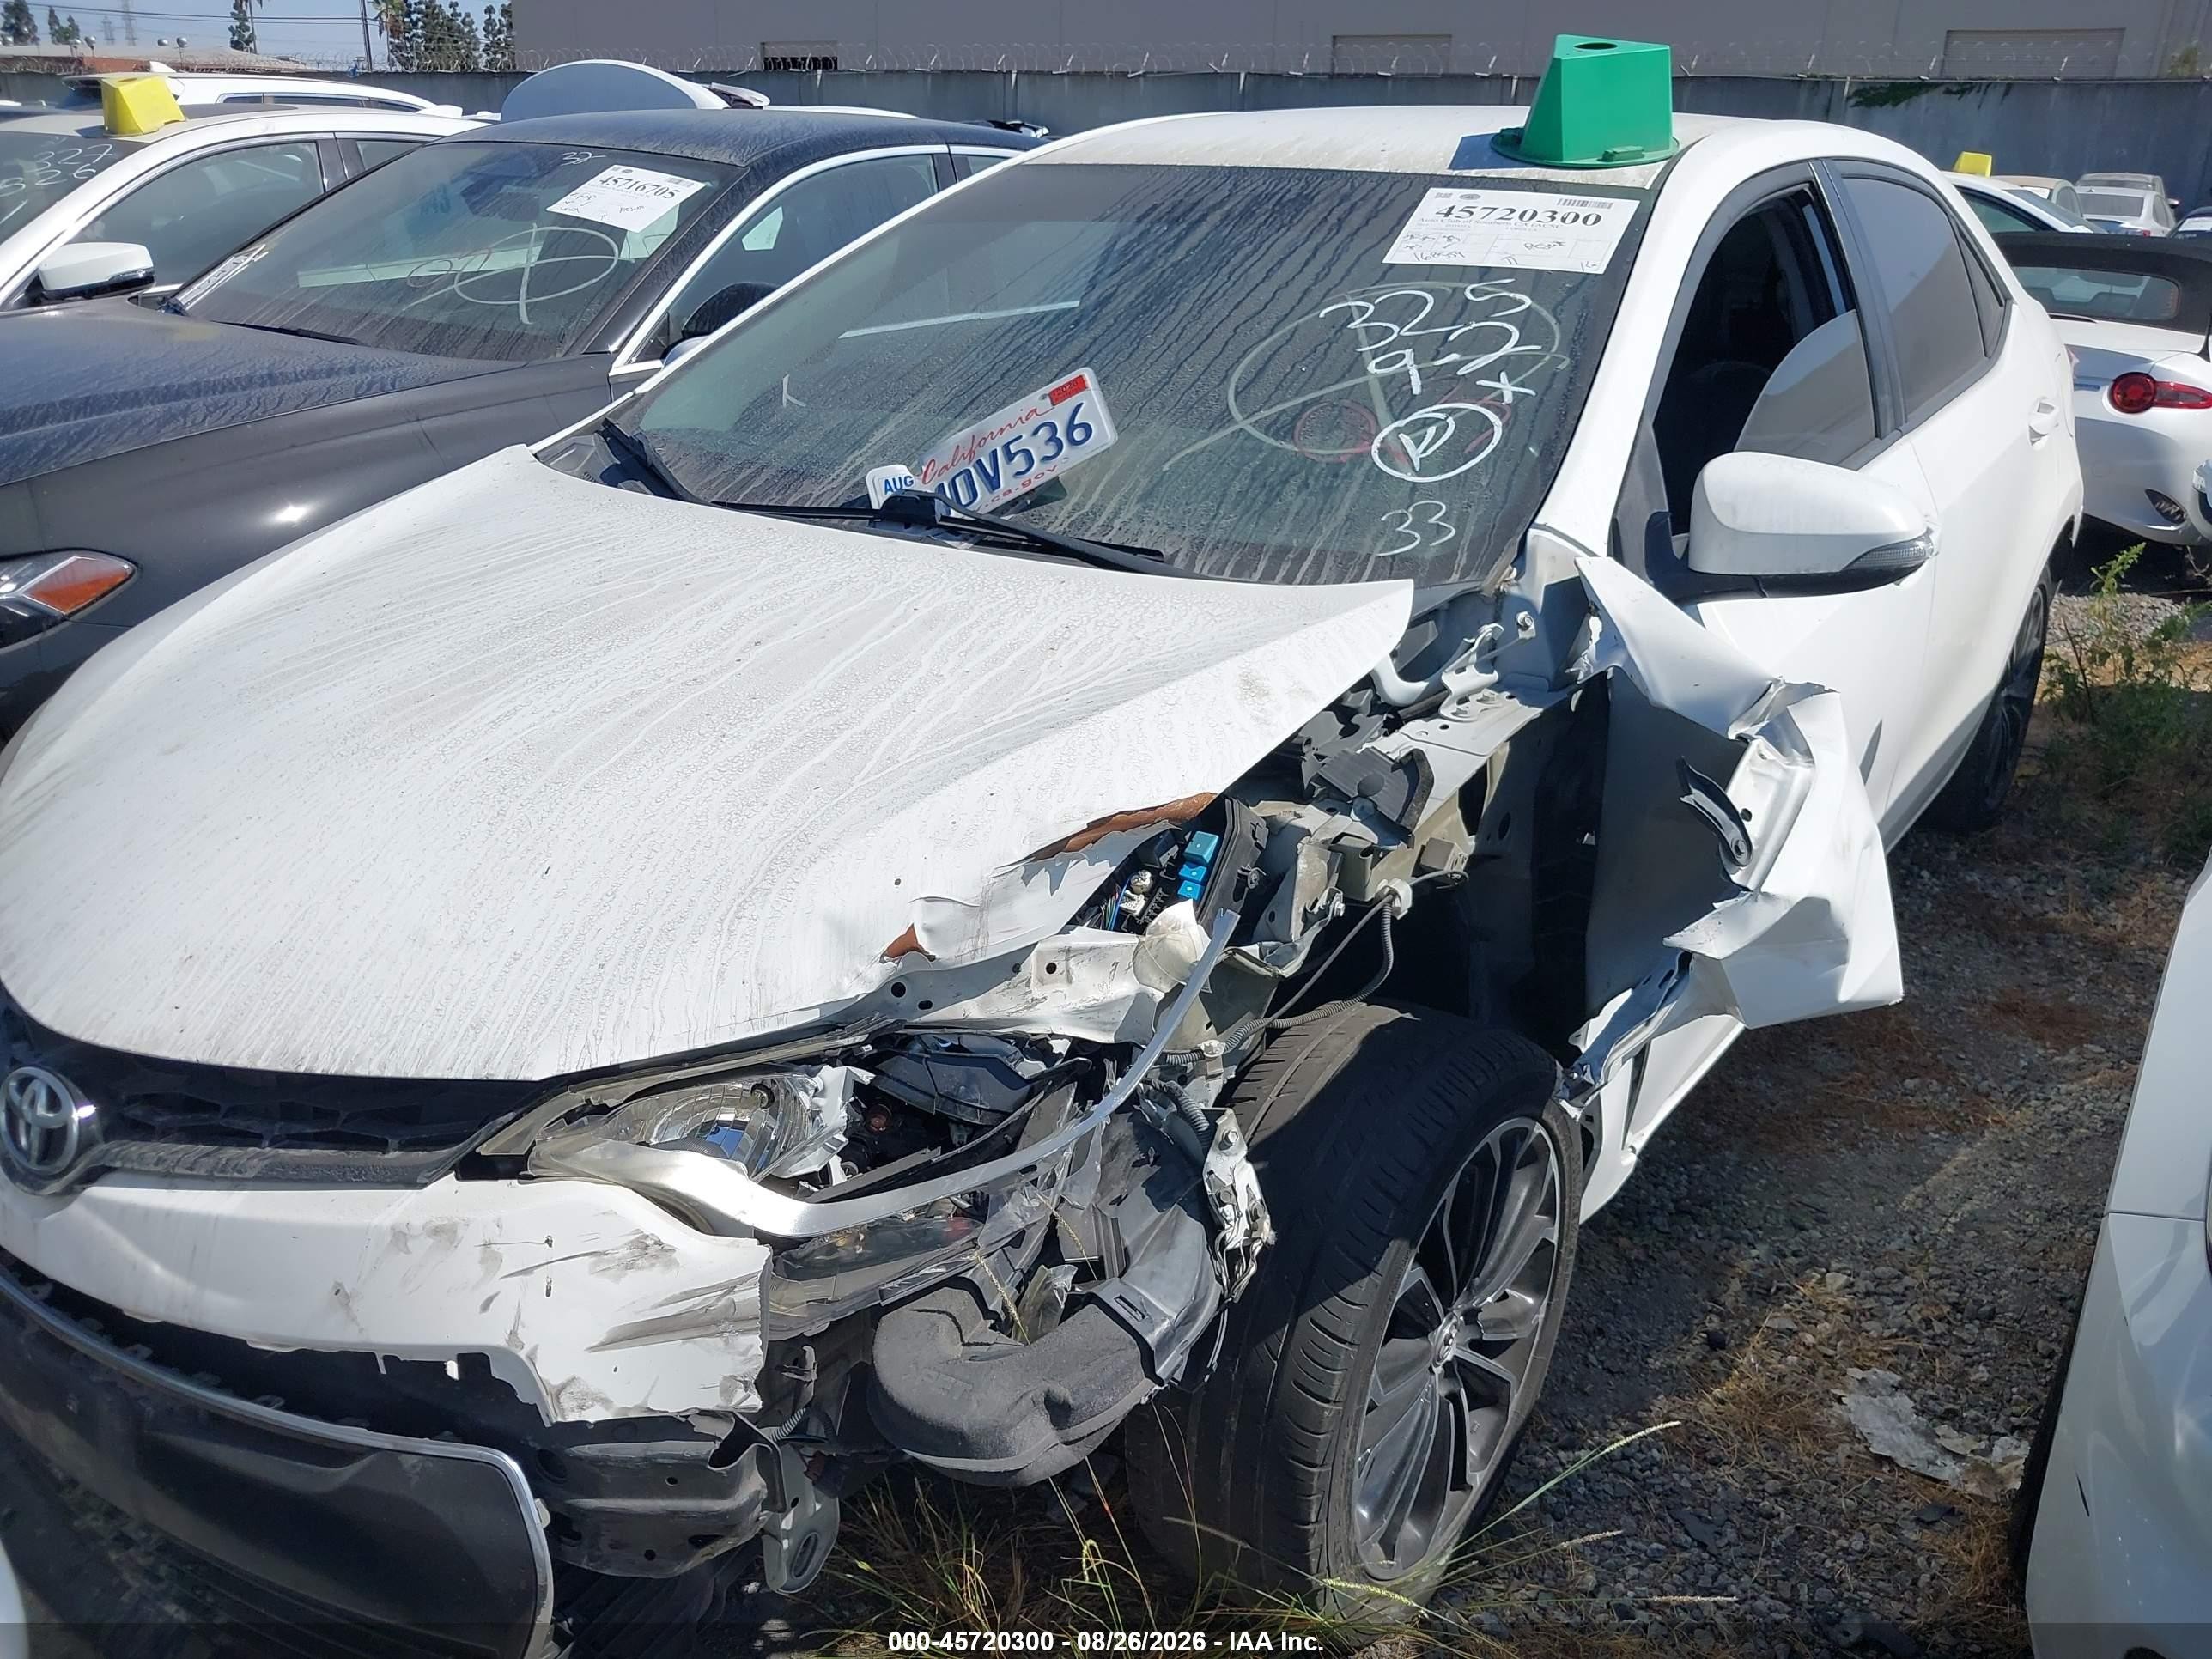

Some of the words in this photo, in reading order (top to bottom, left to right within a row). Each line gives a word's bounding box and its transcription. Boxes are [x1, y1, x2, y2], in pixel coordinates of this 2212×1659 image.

[599, 175, 681, 200] 45716705
[1435, 204, 1602, 227] 45720300
[921, 405, 1054, 486] California
[884, 474, 915, 495] AUG
[1375, 500, 1457, 557] 33
